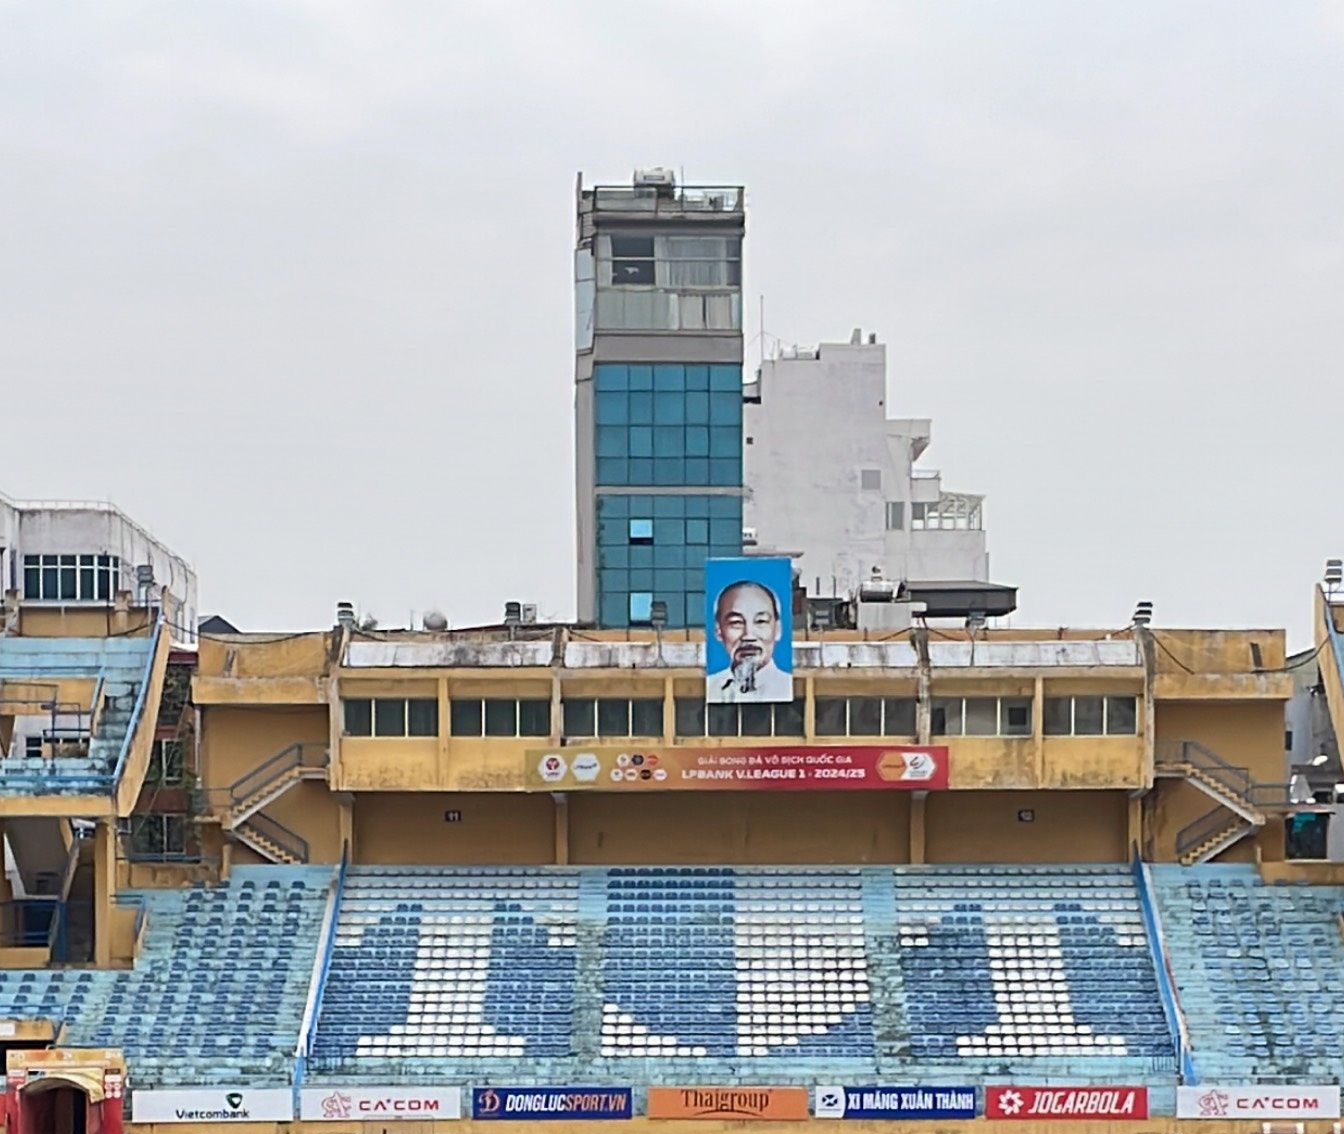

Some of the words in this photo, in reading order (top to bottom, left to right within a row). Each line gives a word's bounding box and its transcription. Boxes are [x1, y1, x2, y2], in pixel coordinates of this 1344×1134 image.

[682, 769, 733, 780] LPBANK
[736, 769, 796, 780] V.LEAGUE
[814, 768, 866, 779] 2024/25
[680, 1089, 769, 1112] Thaigroup
[847, 1092, 860, 1109] XI
[1028, 1091, 1136, 1113] JOGARBOLA
[176, 1108, 250, 1119] Vietcombank
